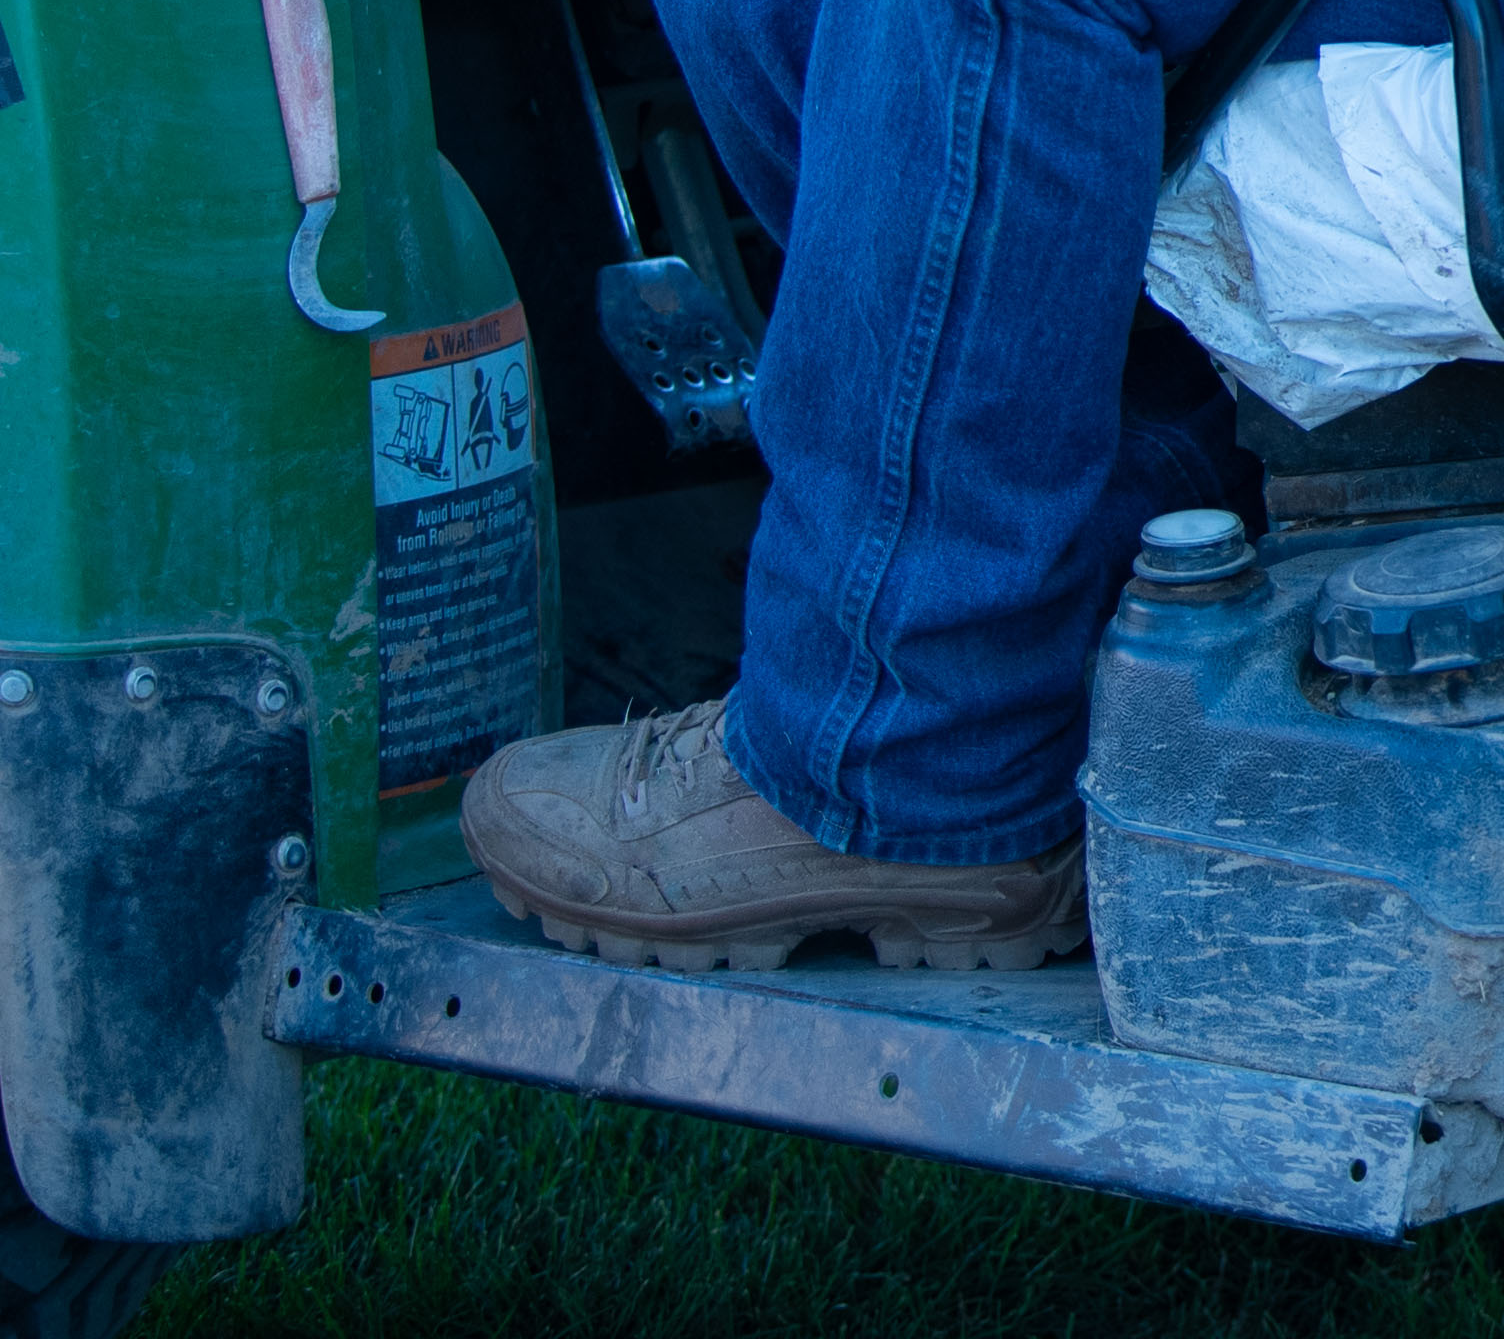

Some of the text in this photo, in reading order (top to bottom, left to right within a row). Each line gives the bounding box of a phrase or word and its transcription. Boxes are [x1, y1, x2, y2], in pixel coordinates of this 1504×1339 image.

[441, 319, 501, 357] WARNING
[416, 485, 517, 528] Avoid Injury or Death
[397, 533, 426, 554] from
[476, 519, 486, 534] or
[488, 507, 516, 529] Falling
[384, 565, 407, 580] Wear
[385, 594, 395, 606] or
[395, 588, 424, 604] uneven
[385, 605, 458, 631] Keep arms and legs
[387, 719, 403, 734] Use
[404, 714, 430, 731] brakes
[387, 745, 401, 759] For
